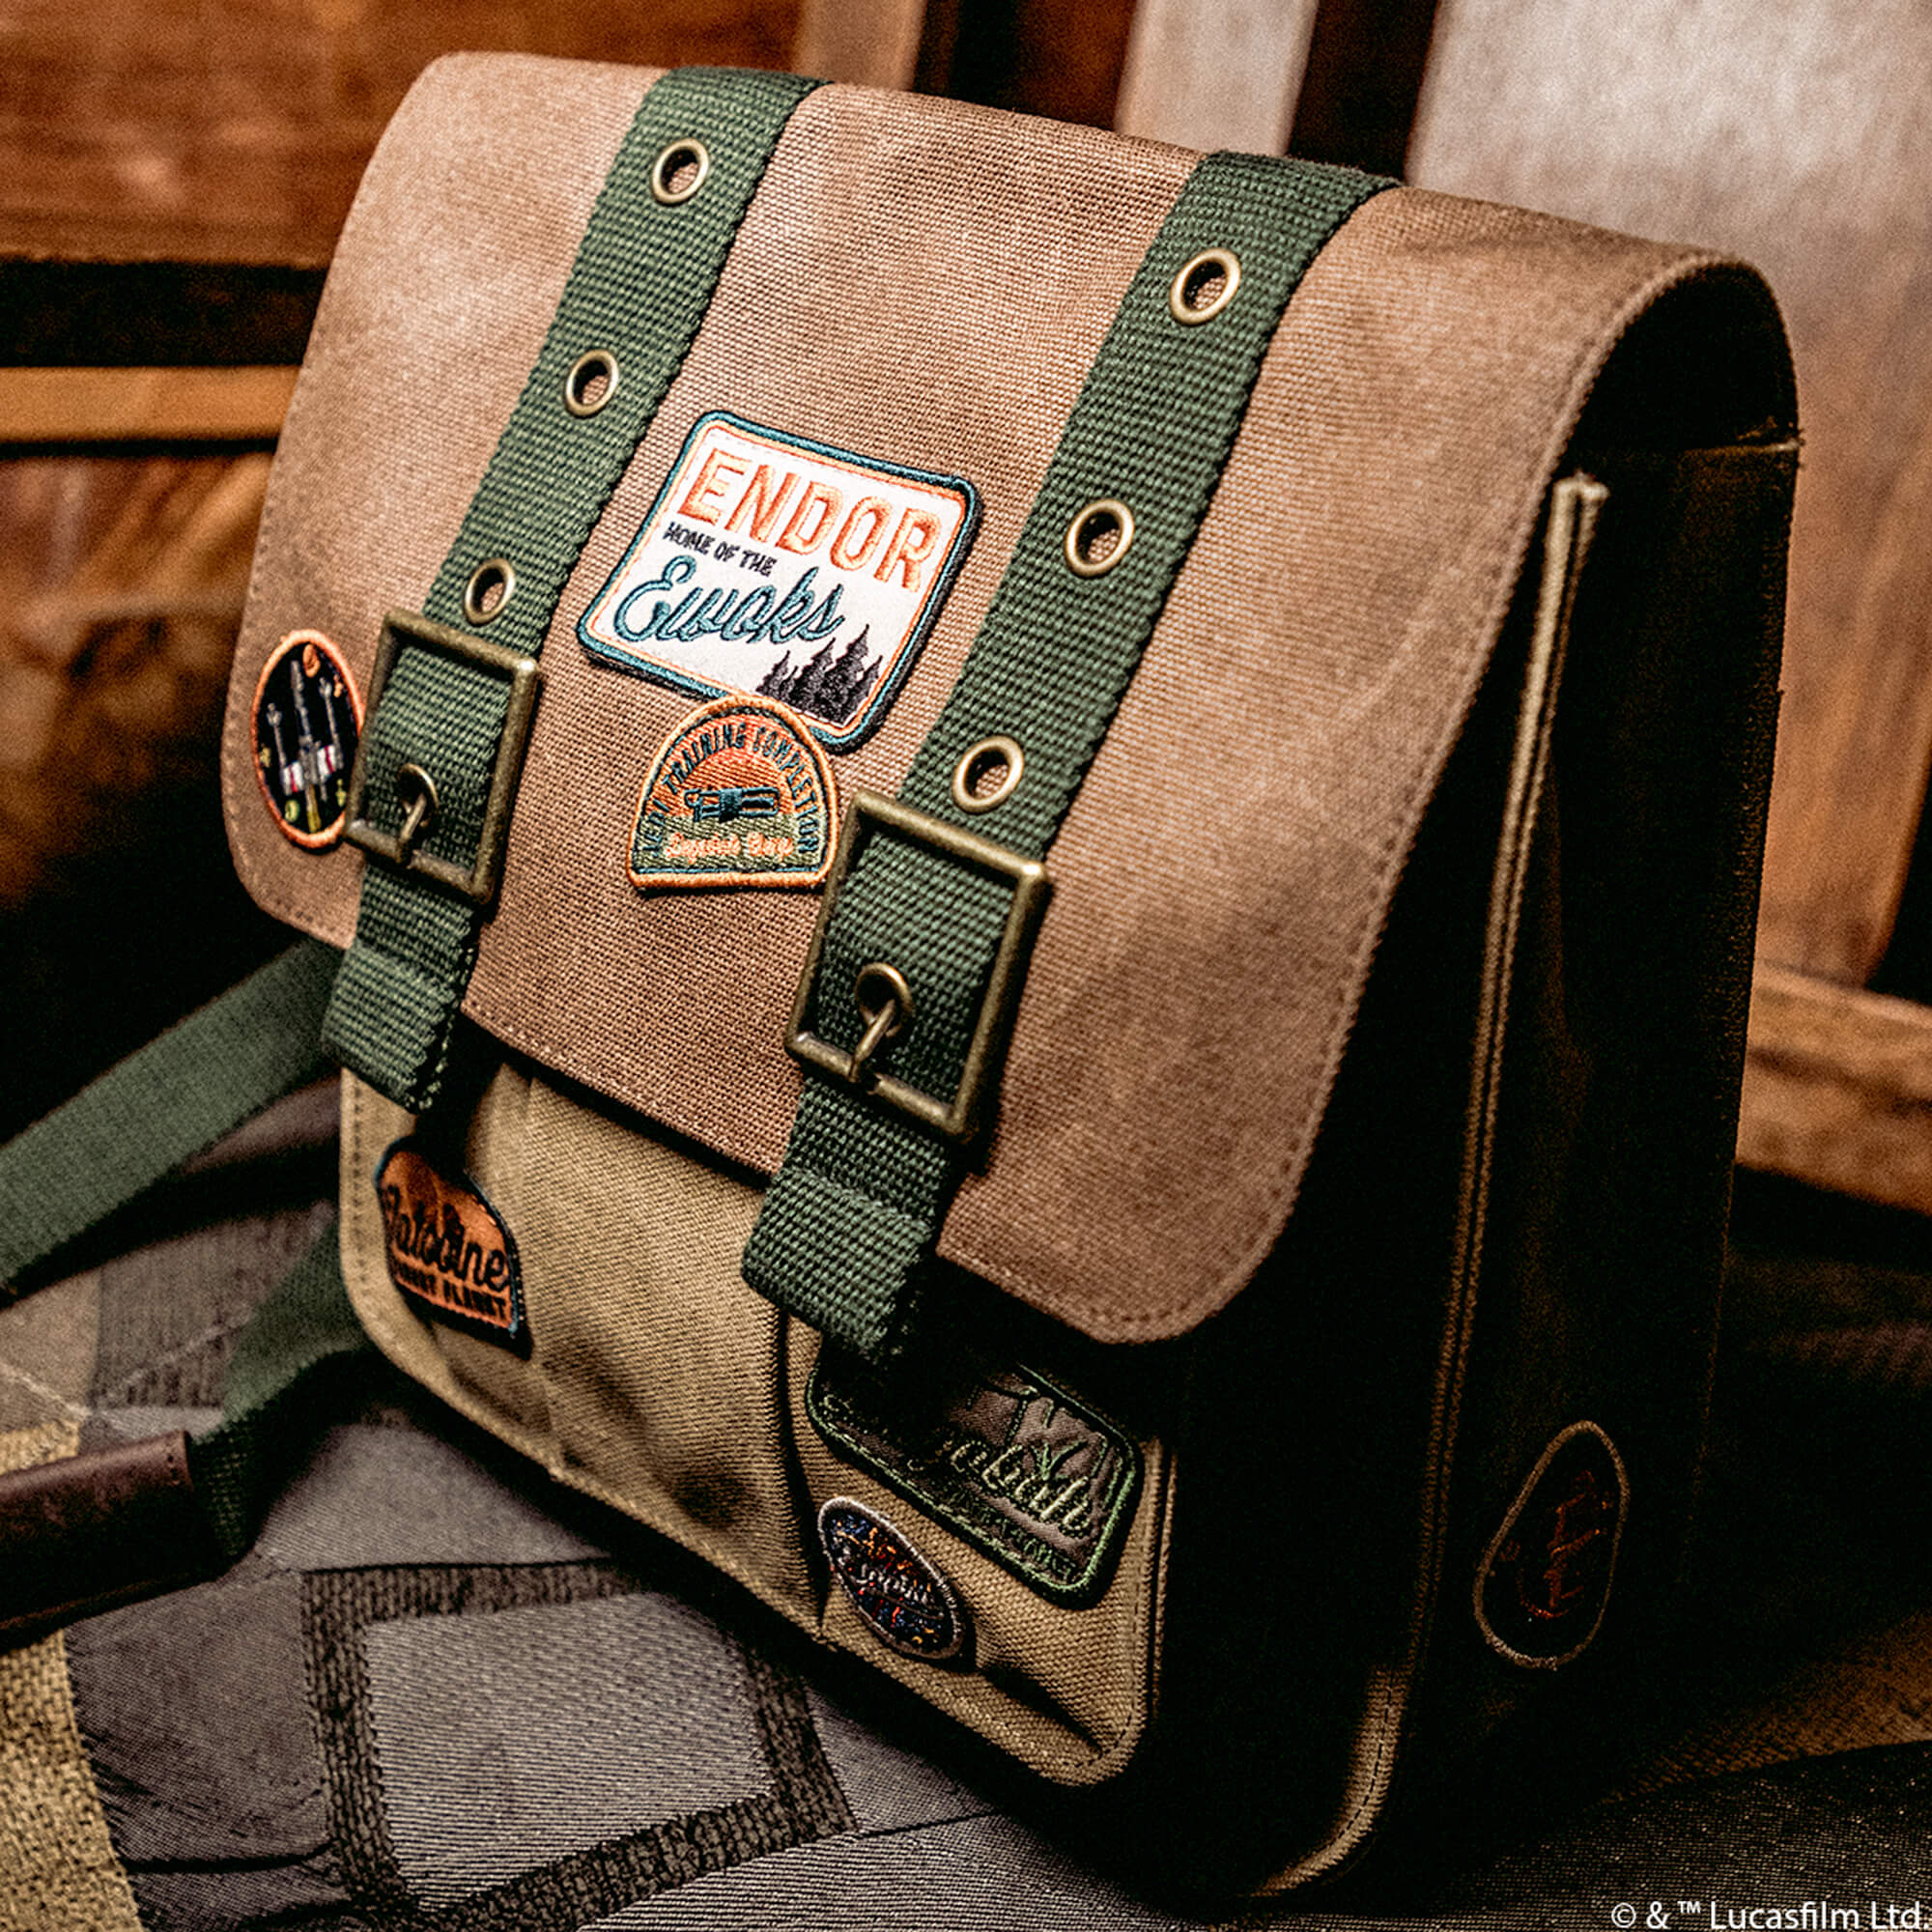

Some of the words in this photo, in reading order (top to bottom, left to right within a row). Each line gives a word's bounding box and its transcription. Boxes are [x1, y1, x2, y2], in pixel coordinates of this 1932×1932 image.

[663, 522, 709, 555] HOME
[716, 541, 735, 562] OF
[737, 549, 777, 577] THE
[678, 447, 941, 592] ENDOR
[613, 554, 846, 645] Ewoks
[662, 722, 747, 795] TRAINING
[753, 725, 819, 854] COMPLETION
